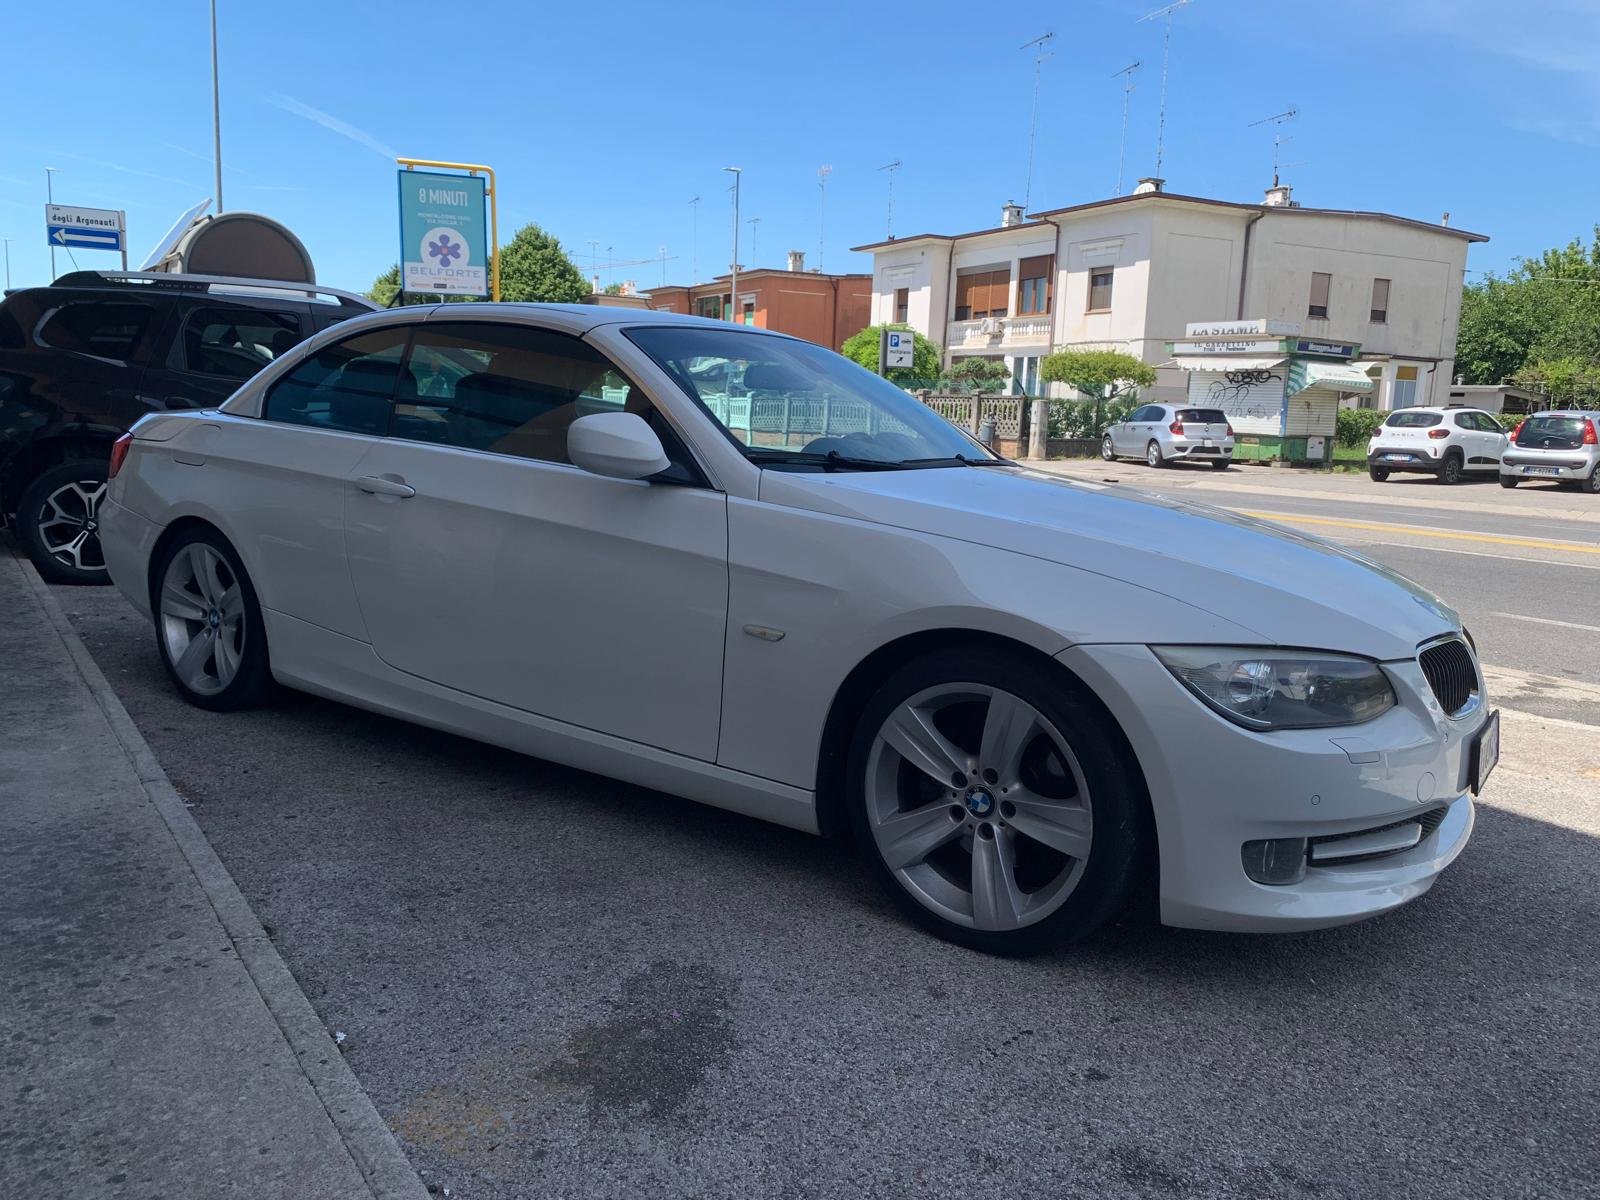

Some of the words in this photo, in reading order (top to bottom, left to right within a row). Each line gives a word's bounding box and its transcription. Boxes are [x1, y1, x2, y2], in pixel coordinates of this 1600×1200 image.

[418, 187, 426, 204] 8
[429, 188, 468, 207] MINUTI
[52, 214, 73, 223] degli
[76, 216, 115, 226] Argonauti
[410, 266, 480, 278] BELFORTE
